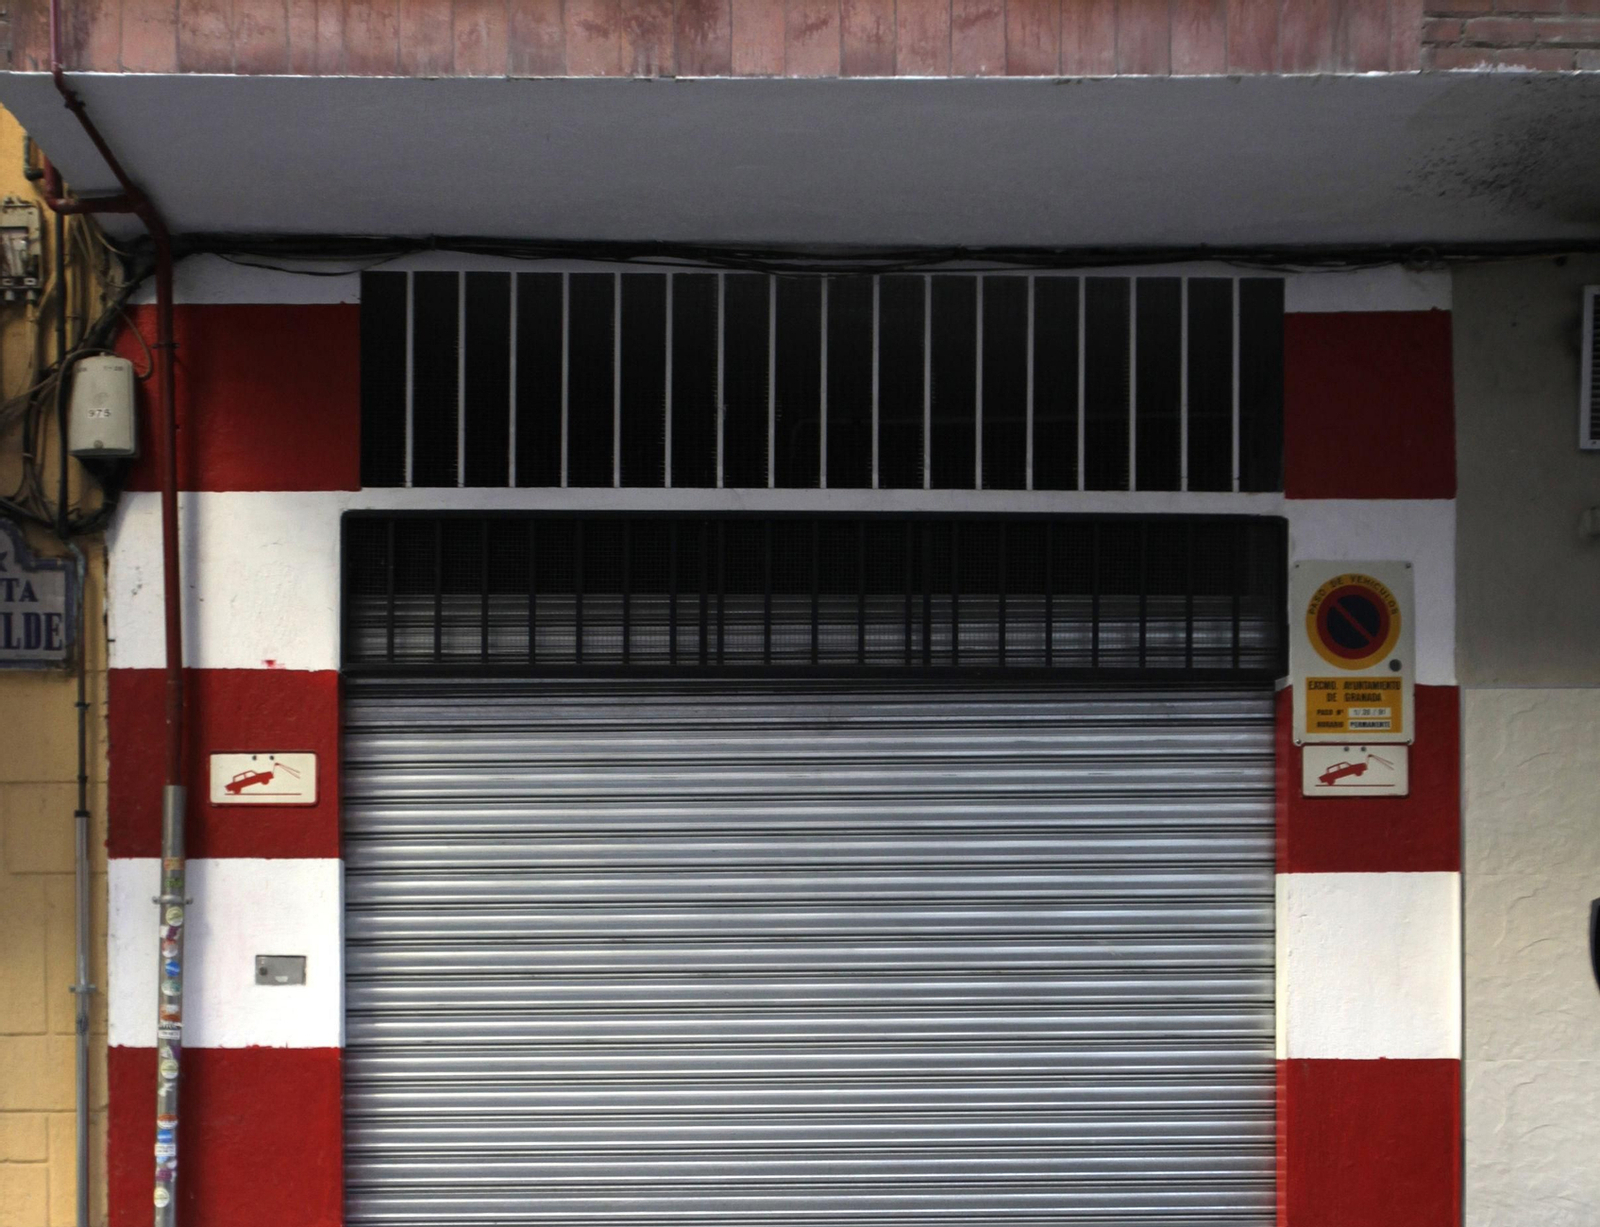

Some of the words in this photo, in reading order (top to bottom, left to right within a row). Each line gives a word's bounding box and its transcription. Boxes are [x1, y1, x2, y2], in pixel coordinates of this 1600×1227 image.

[1309, 588, 1326, 615] PASO
[1330, 576, 1343, 587] DE
[1350, 575, 1399, 615] VEHICULOS
[1343, 680, 1401, 690] AYUNTAMIENTO
[1326, 692, 1337, 702] DE
[1344, 692, 1382, 702] GRANADA
